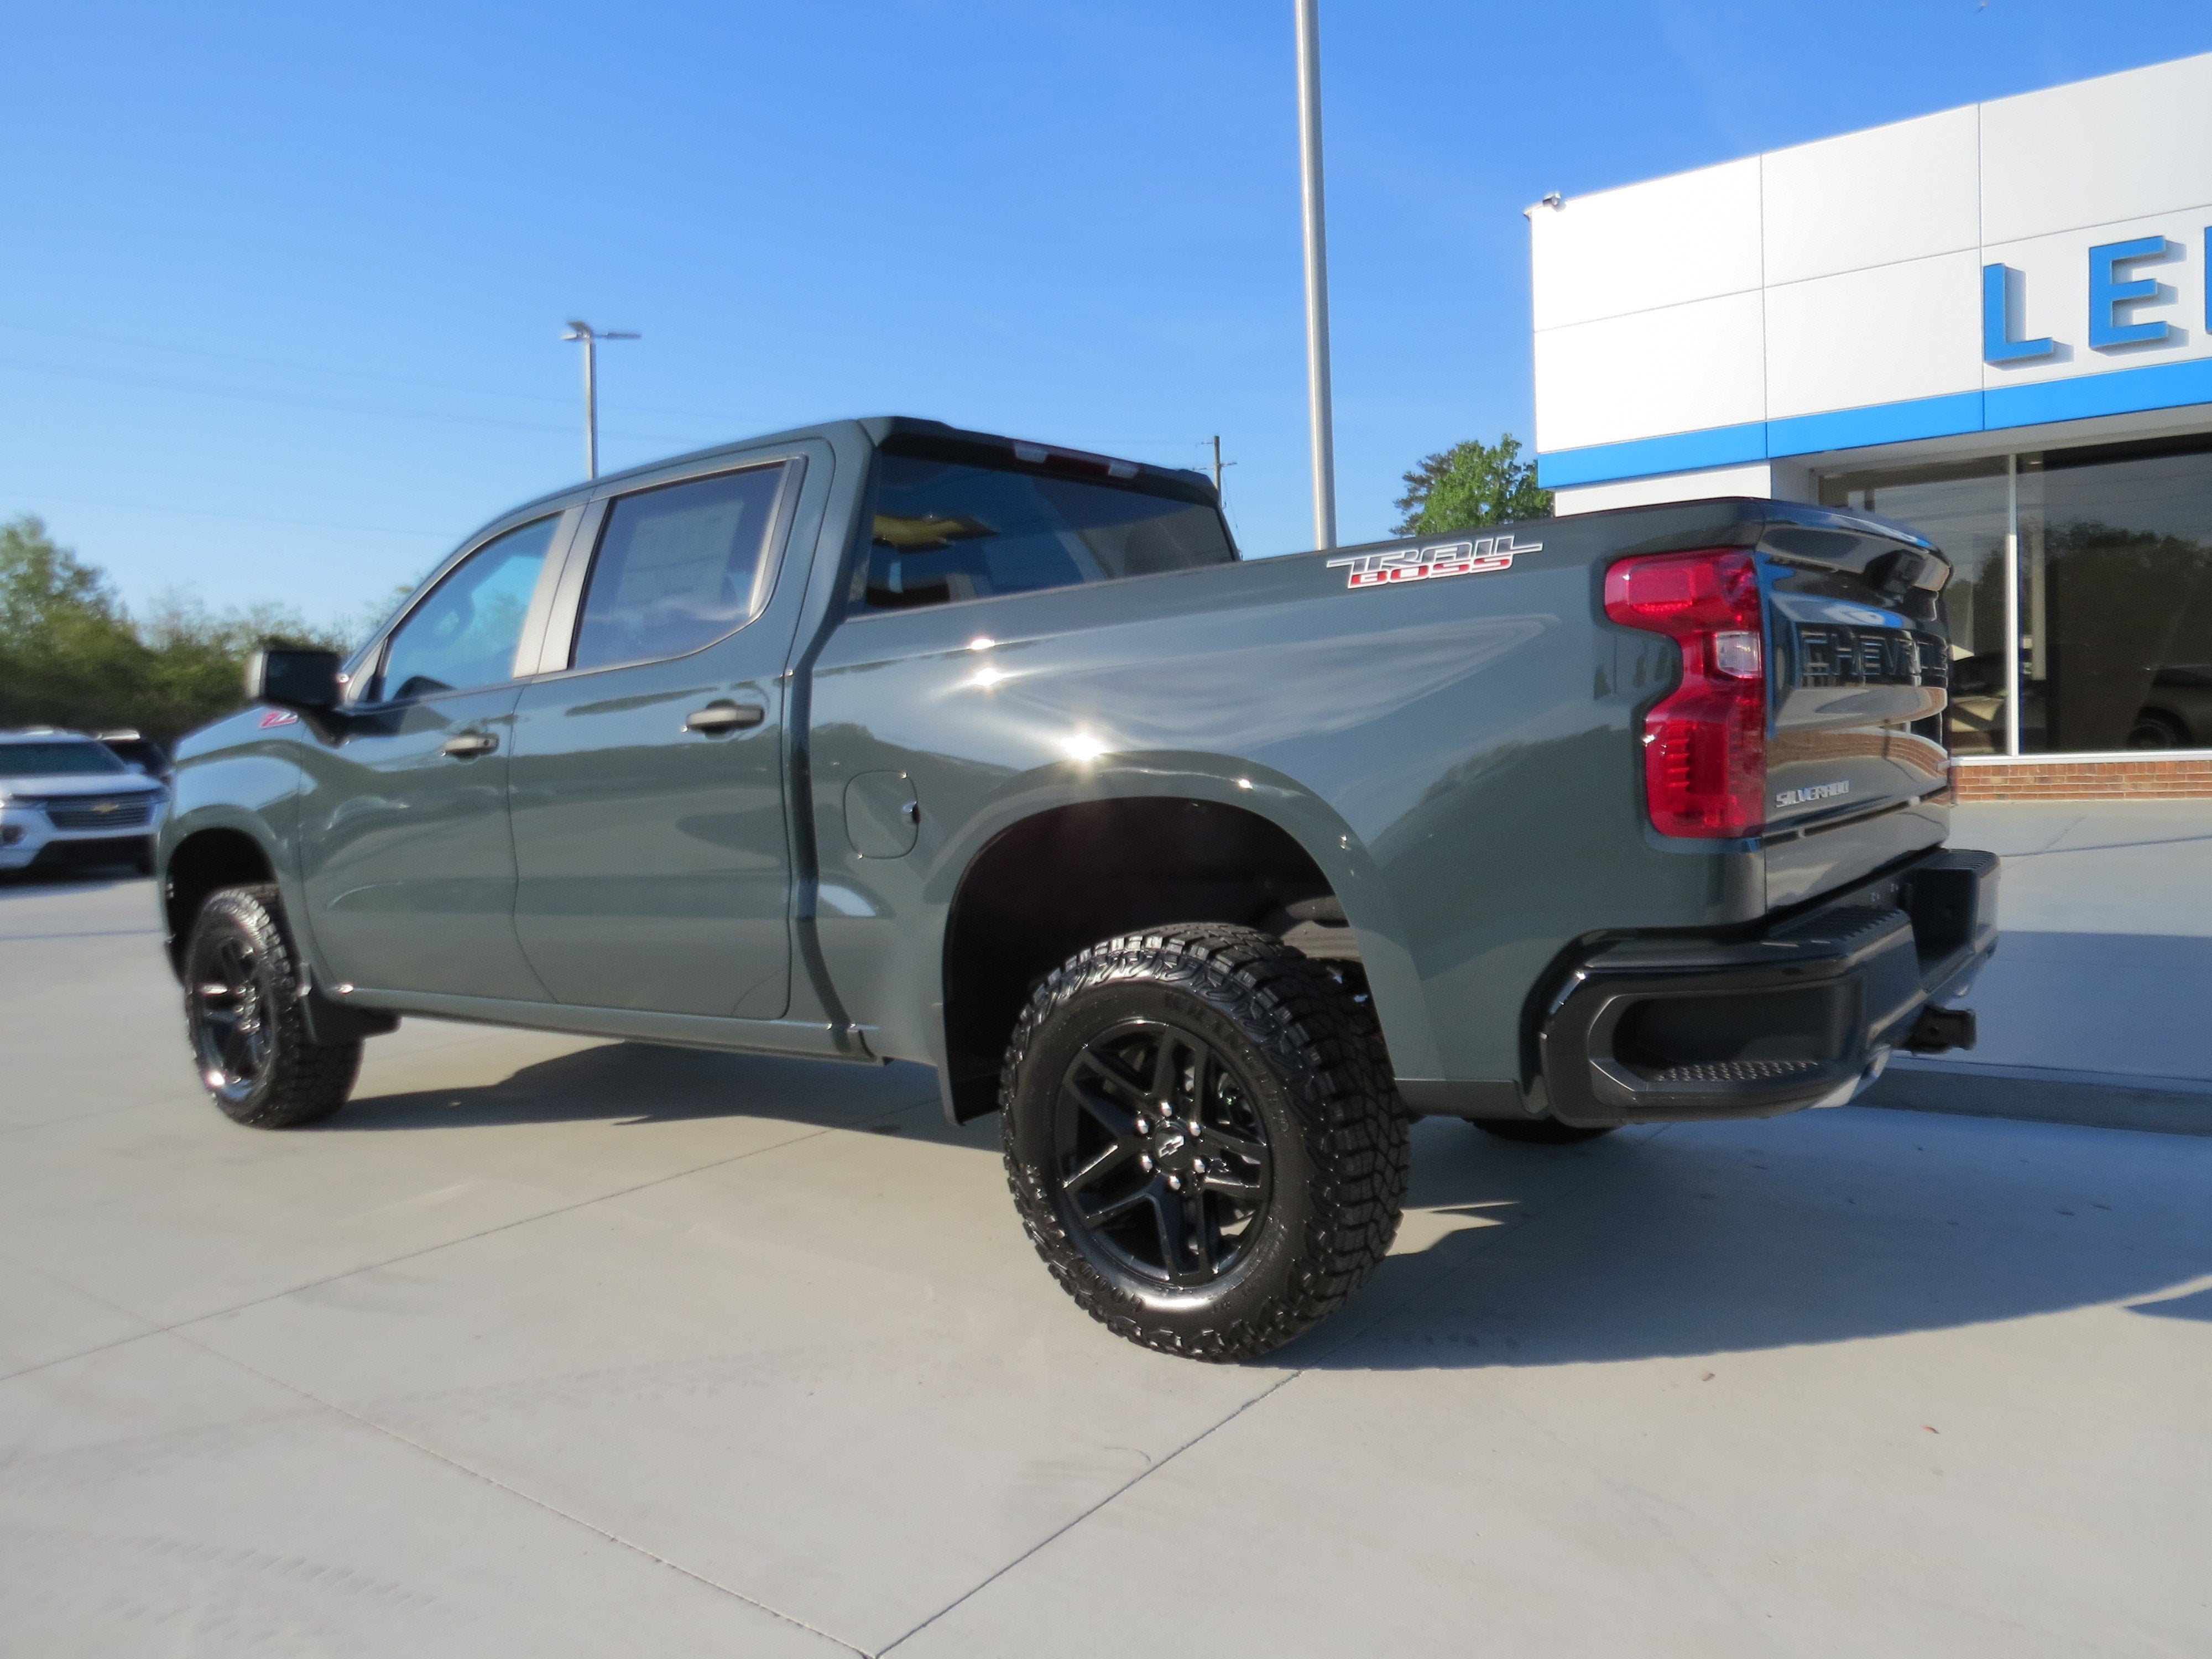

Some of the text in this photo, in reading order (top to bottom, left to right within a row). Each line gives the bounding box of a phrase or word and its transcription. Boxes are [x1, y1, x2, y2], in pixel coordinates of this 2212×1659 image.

[1983, 226, 2212, 363] LE
[1327, 534, 1543, 573] TRAIL
[1348, 556, 1514, 589] BOSS
